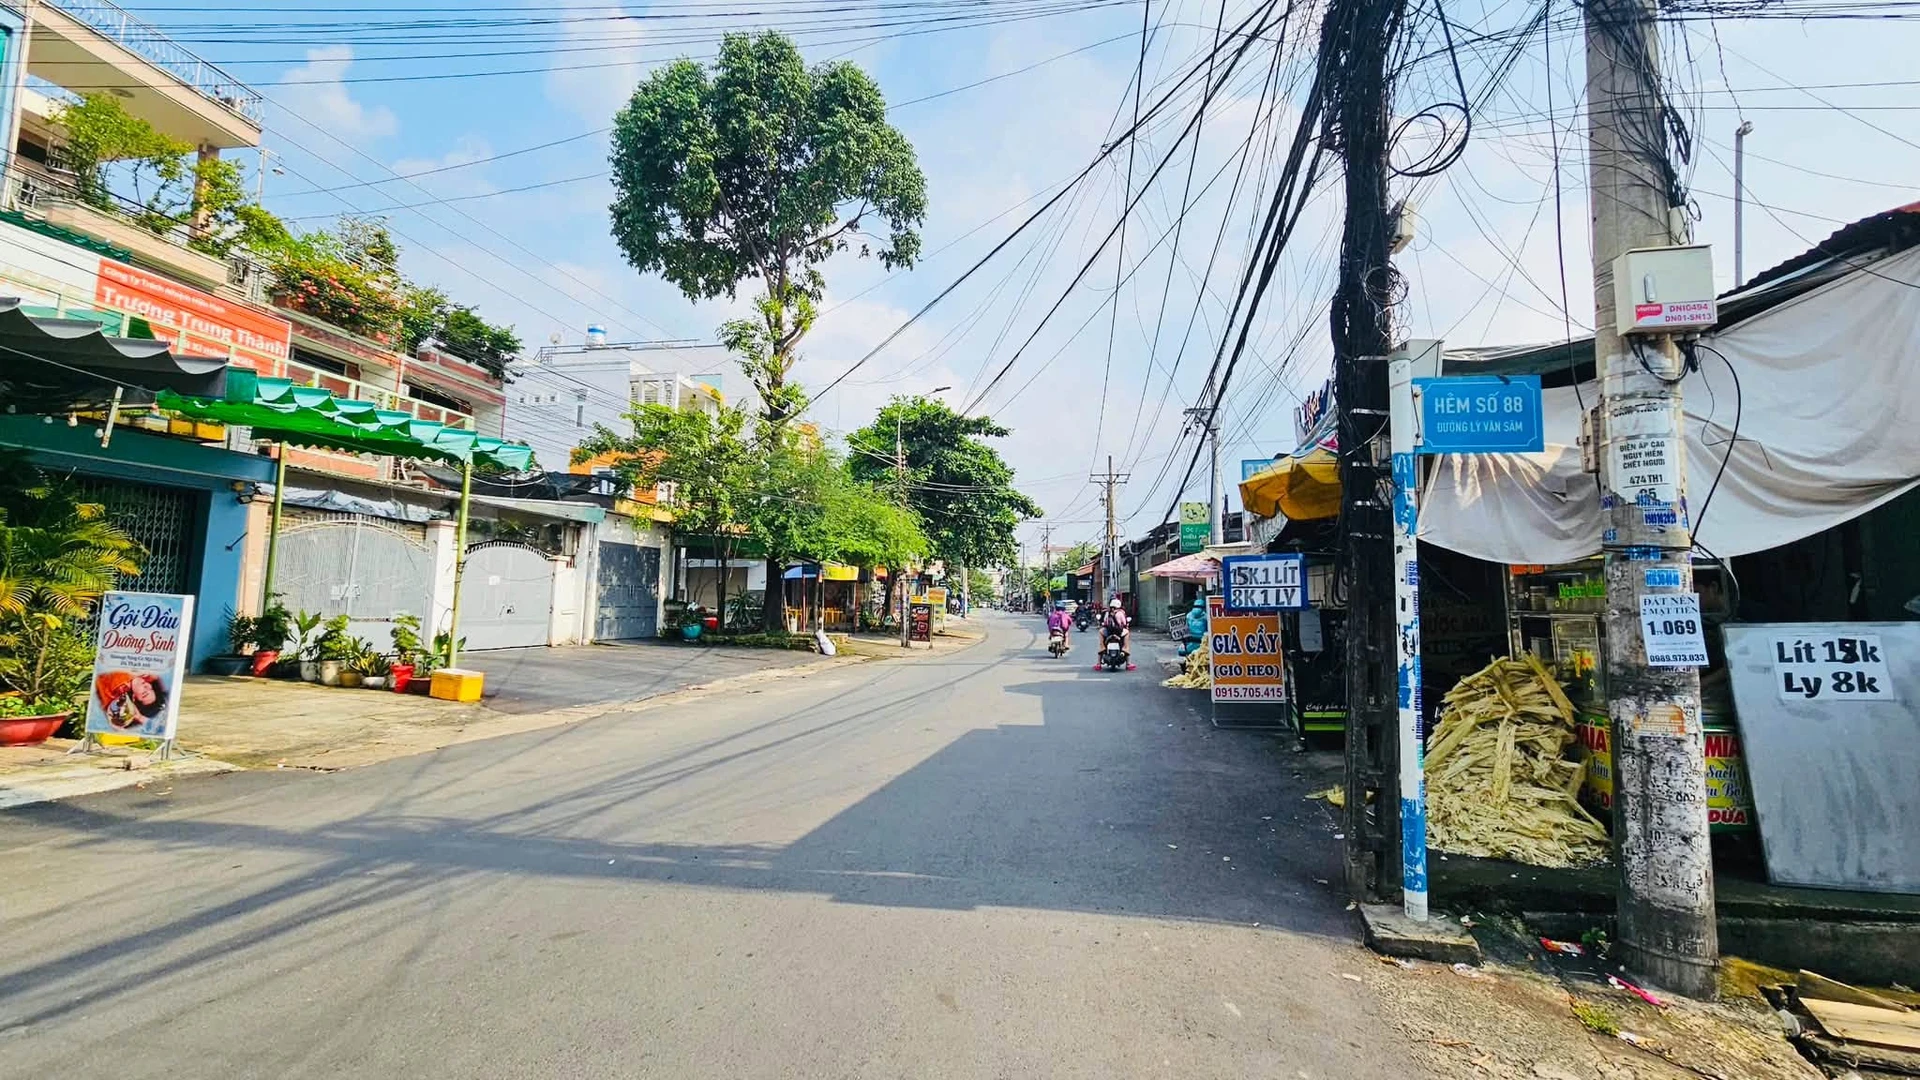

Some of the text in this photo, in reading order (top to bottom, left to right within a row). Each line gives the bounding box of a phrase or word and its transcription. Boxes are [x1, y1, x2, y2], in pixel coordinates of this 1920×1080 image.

[180, 311, 233, 345] Trung
[237, 328, 286, 359] Thành
[1475, 391, 1499, 413] SỐ
[1503, 396, 1523, 413] 88
[1275, 561, 1298, 584] LÍT
[1275, 588, 1296, 606] LY
[109, 603, 179, 630] Gội Đầu
[145, 631, 176, 652] Sinh
[1213, 624, 1278, 653] GIẢ CẦY
[1776, 640, 1816, 663] Lít
[1246, 665, 1280, 678] HEO)
[1215, 687, 1283, 698] 0915.705.415
[1784, 671, 1881, 698] Ly 8k
